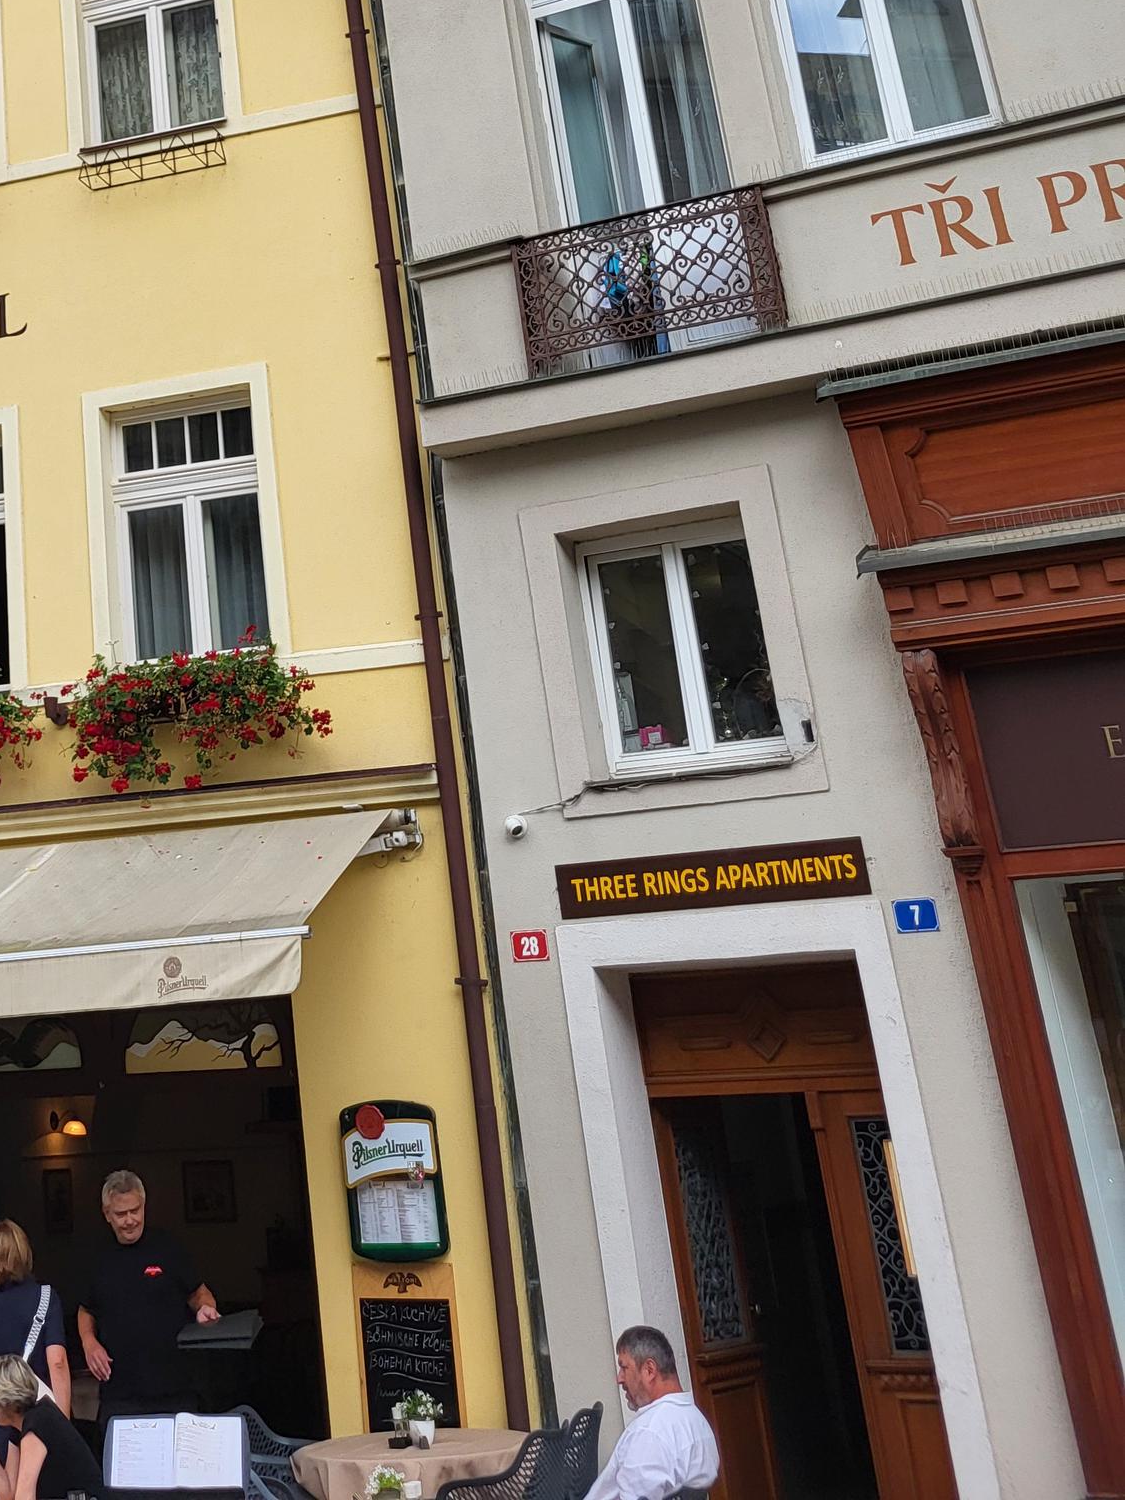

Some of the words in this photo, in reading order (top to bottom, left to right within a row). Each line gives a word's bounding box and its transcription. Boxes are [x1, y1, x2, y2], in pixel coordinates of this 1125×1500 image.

[871, 175, 1014, 266] TŘI
[571, 874, 638, 902] THREE
[643, 866, 709, 897] RINGS
[715, 853, 857, 890] APARTMENTS
[909, 904, 921, 927] 7
[521, 936, 540, 956] 28
[352, 1140, 387, 1169] Pilsner
[386, 1138, 424, 1159] Urquell
